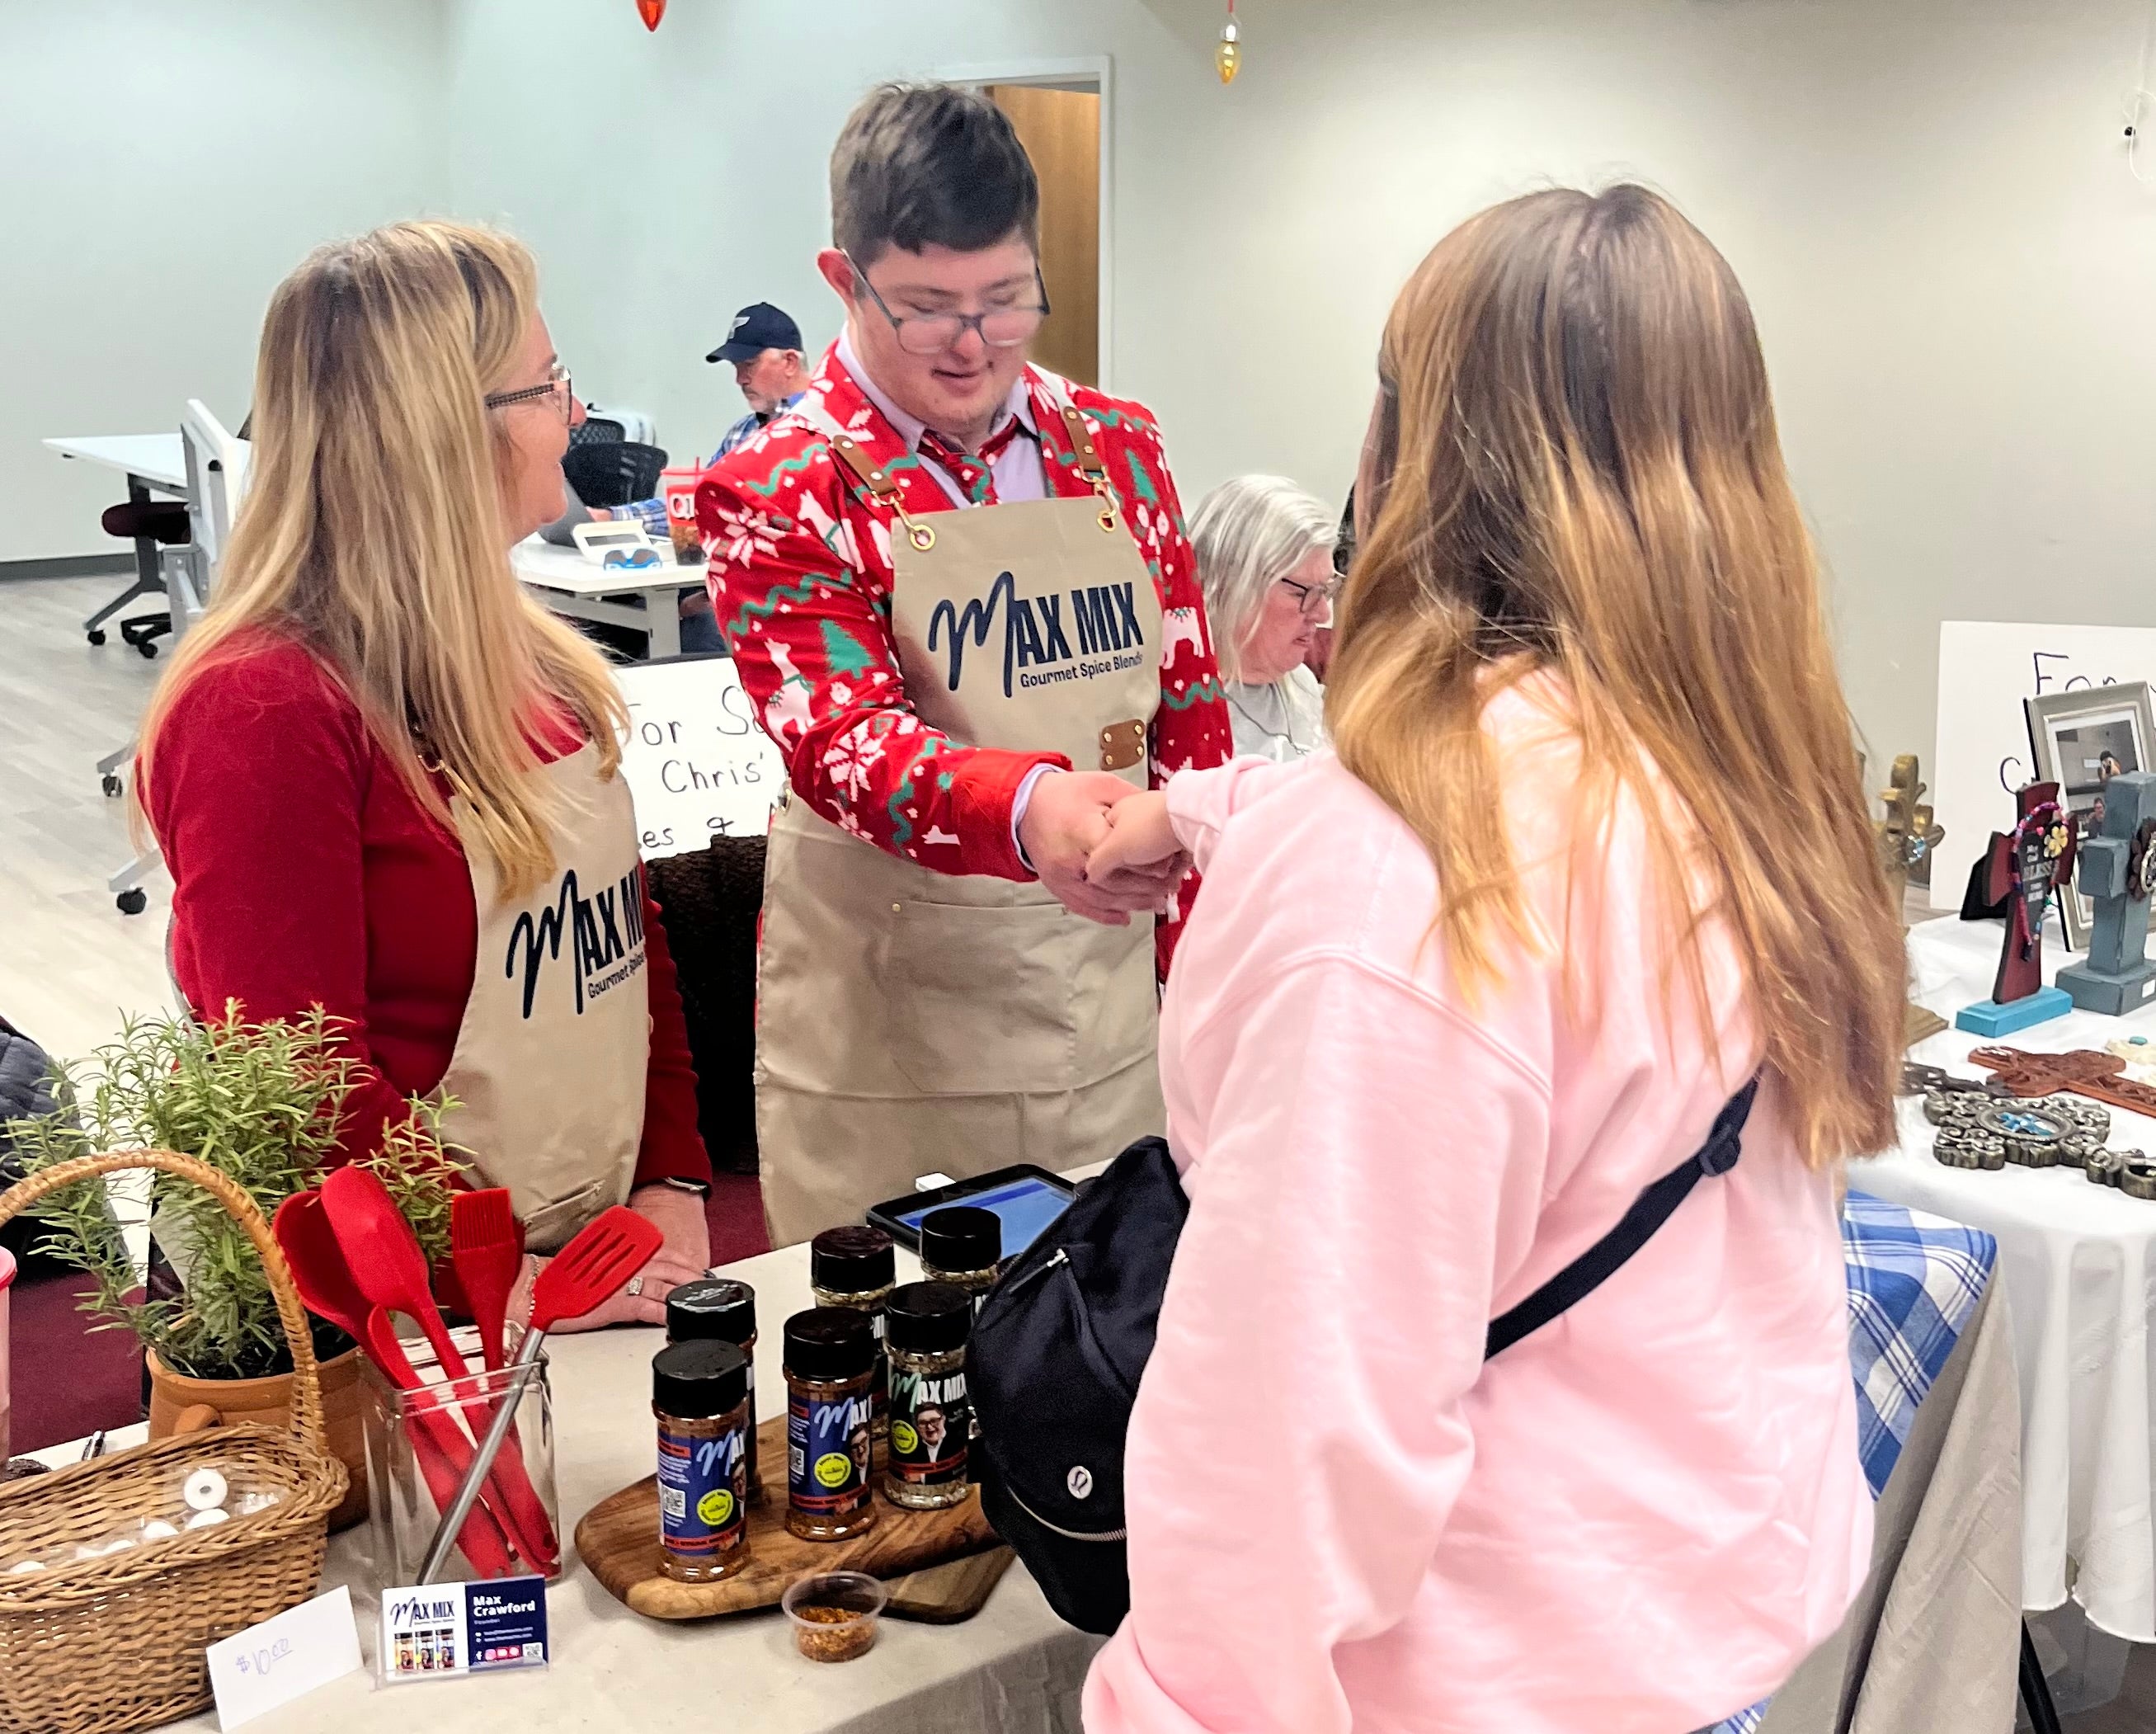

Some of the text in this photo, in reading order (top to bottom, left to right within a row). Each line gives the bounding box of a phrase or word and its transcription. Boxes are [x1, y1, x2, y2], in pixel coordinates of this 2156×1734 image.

[928, 571, 1144, 698] MAX MIX
[1019, 665, 1078, 688] Gourmet
[1080, 657, 1112, 680] Spice
[625, 702, 682, 746] or
[506, 869, 626, 1020] MAX
[891, 1373, 942, 1414] MAX
[390, 1597, 454, 1628] MAX MIX
[473, 1595, 501, 1606] Max
[473, 1600, 536, 1618] Crawford
